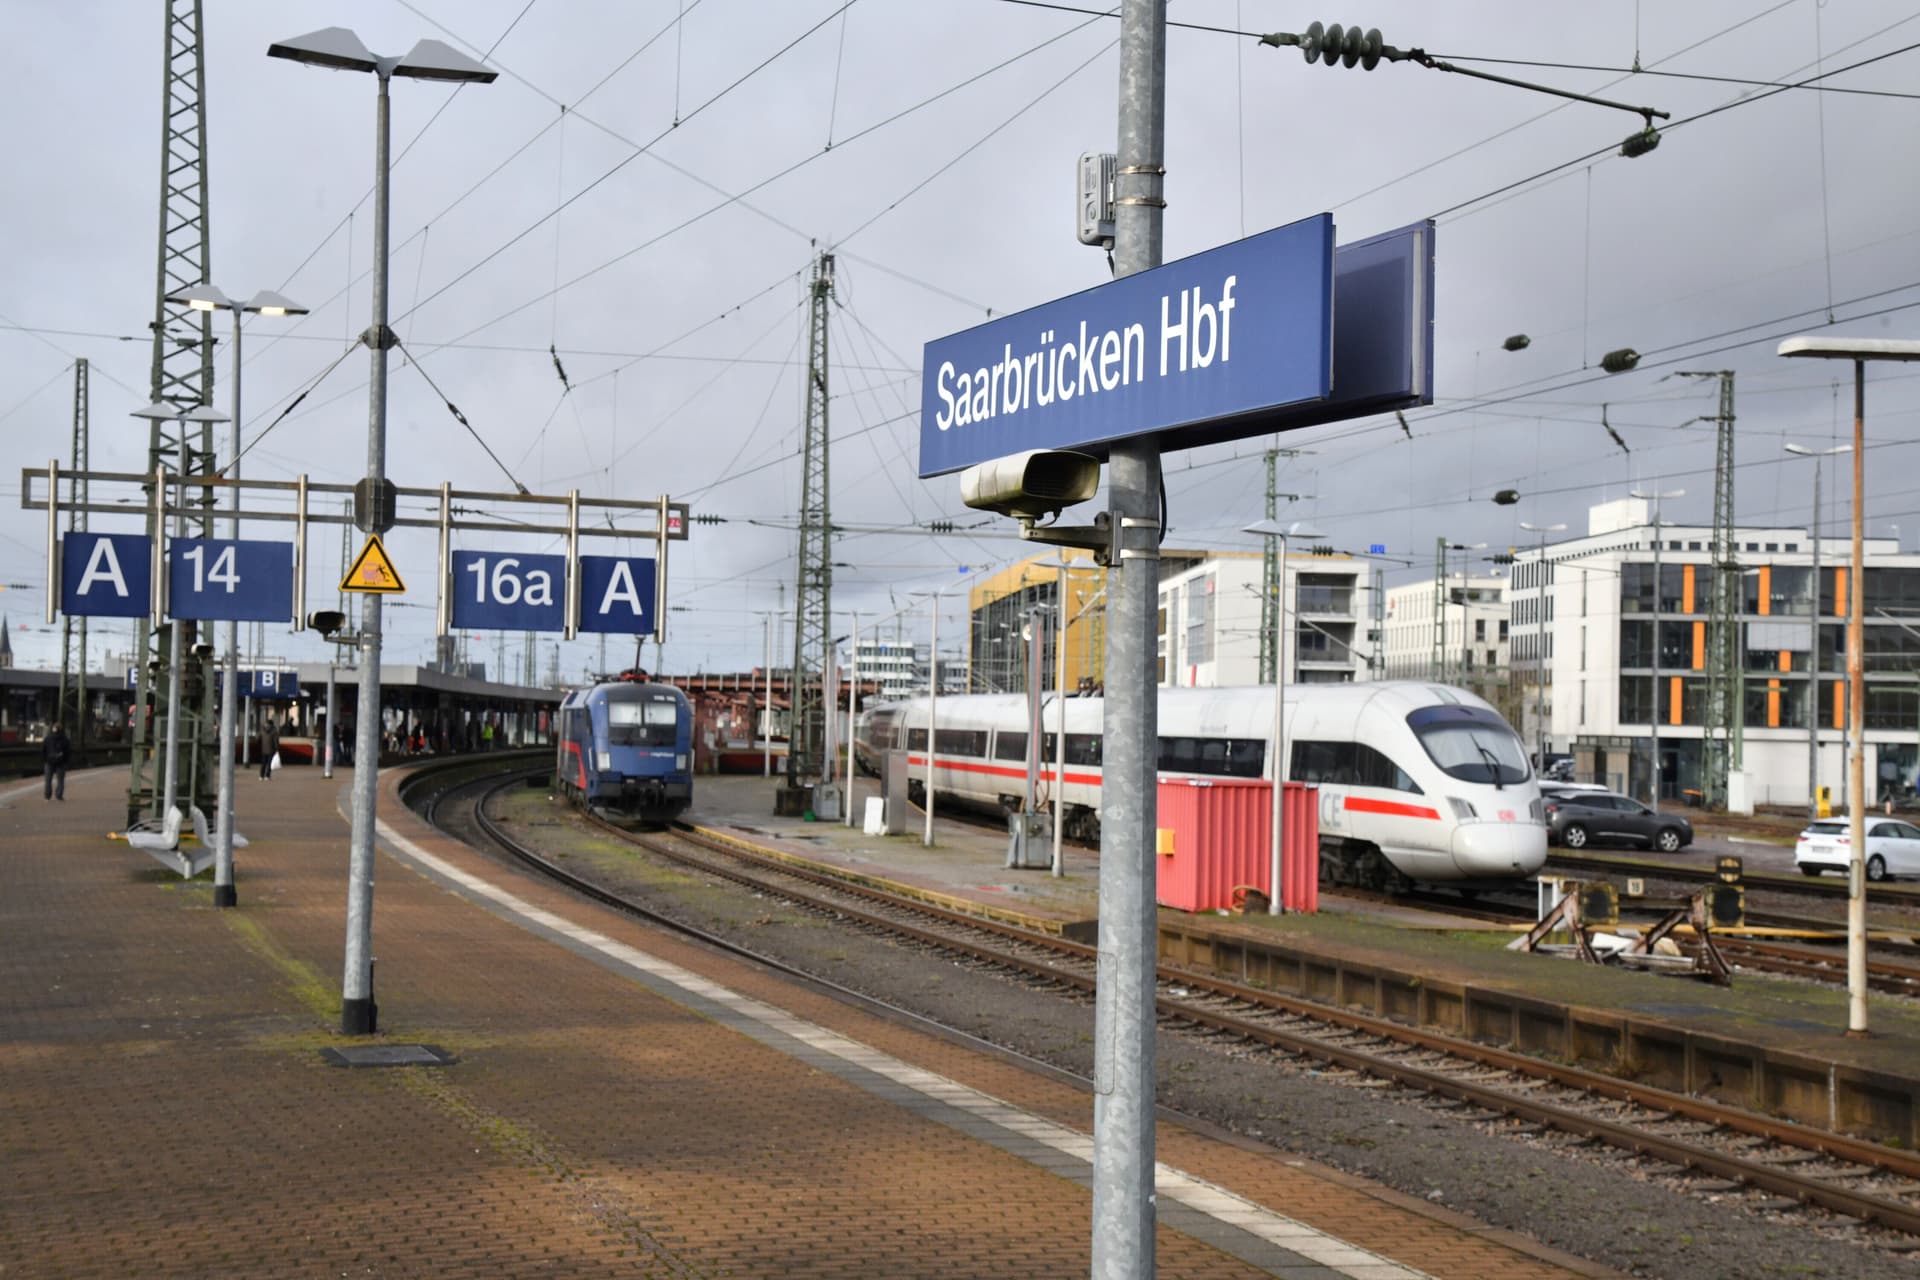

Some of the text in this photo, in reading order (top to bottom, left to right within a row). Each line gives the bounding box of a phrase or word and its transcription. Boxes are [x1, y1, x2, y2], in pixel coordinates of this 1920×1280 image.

[936, 275, 1236, 431] Saarbrücken Hbf
[76, 537, 129, 597] A
[183, 545, 240, 593] 14
[467, 557, 553, 606] 16a
[598, 561, 643, 615] A
[261, 671, 274, 686] B
[1321, 793, 1342, 828] CE
